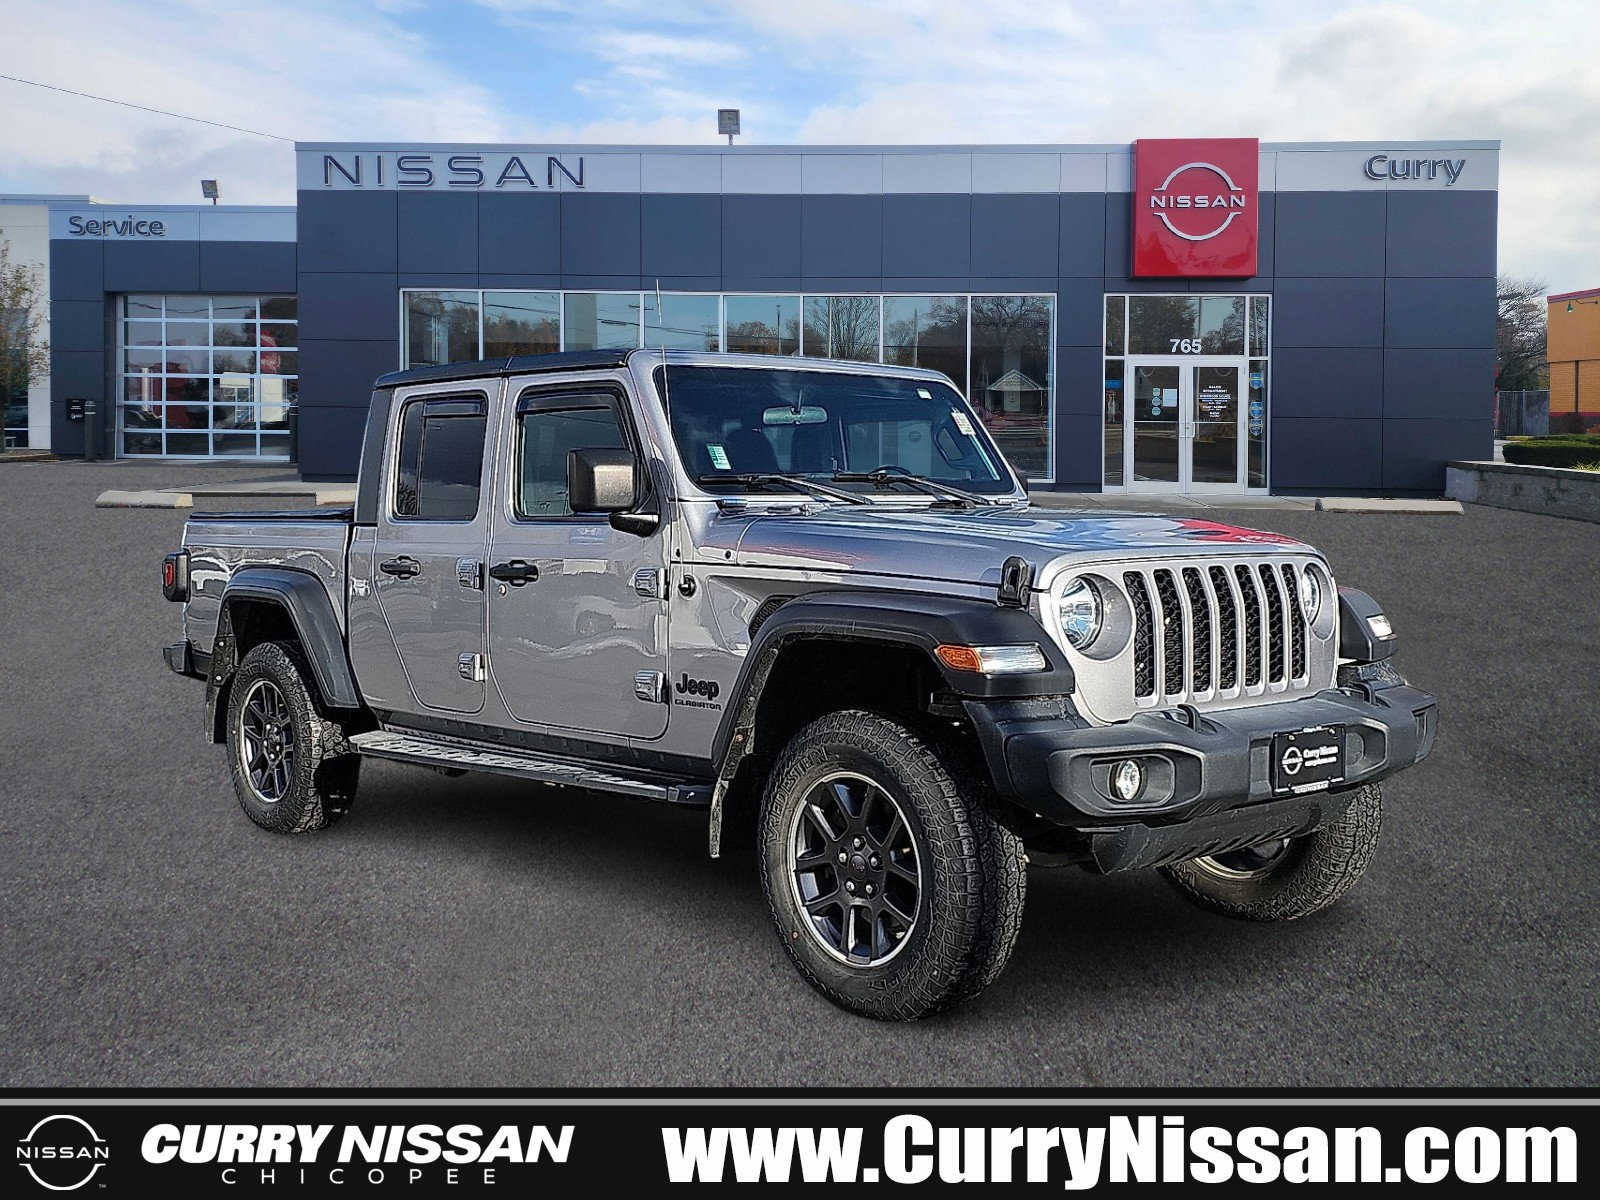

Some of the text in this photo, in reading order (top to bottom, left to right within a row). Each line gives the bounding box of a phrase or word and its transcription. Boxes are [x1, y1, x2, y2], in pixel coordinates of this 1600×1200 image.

[323, 155, 586, 188] NISSAN
[1364, 154, 1466, 186] Curry
[1150, 194, 1246, 208] NISSAN
[69, 214, 166, 236] Service
[1169, 338, 1203, 354] 765
[675, 672, 720, 701] Jeep
[674, 698, 723, 712] GLADIATOR
